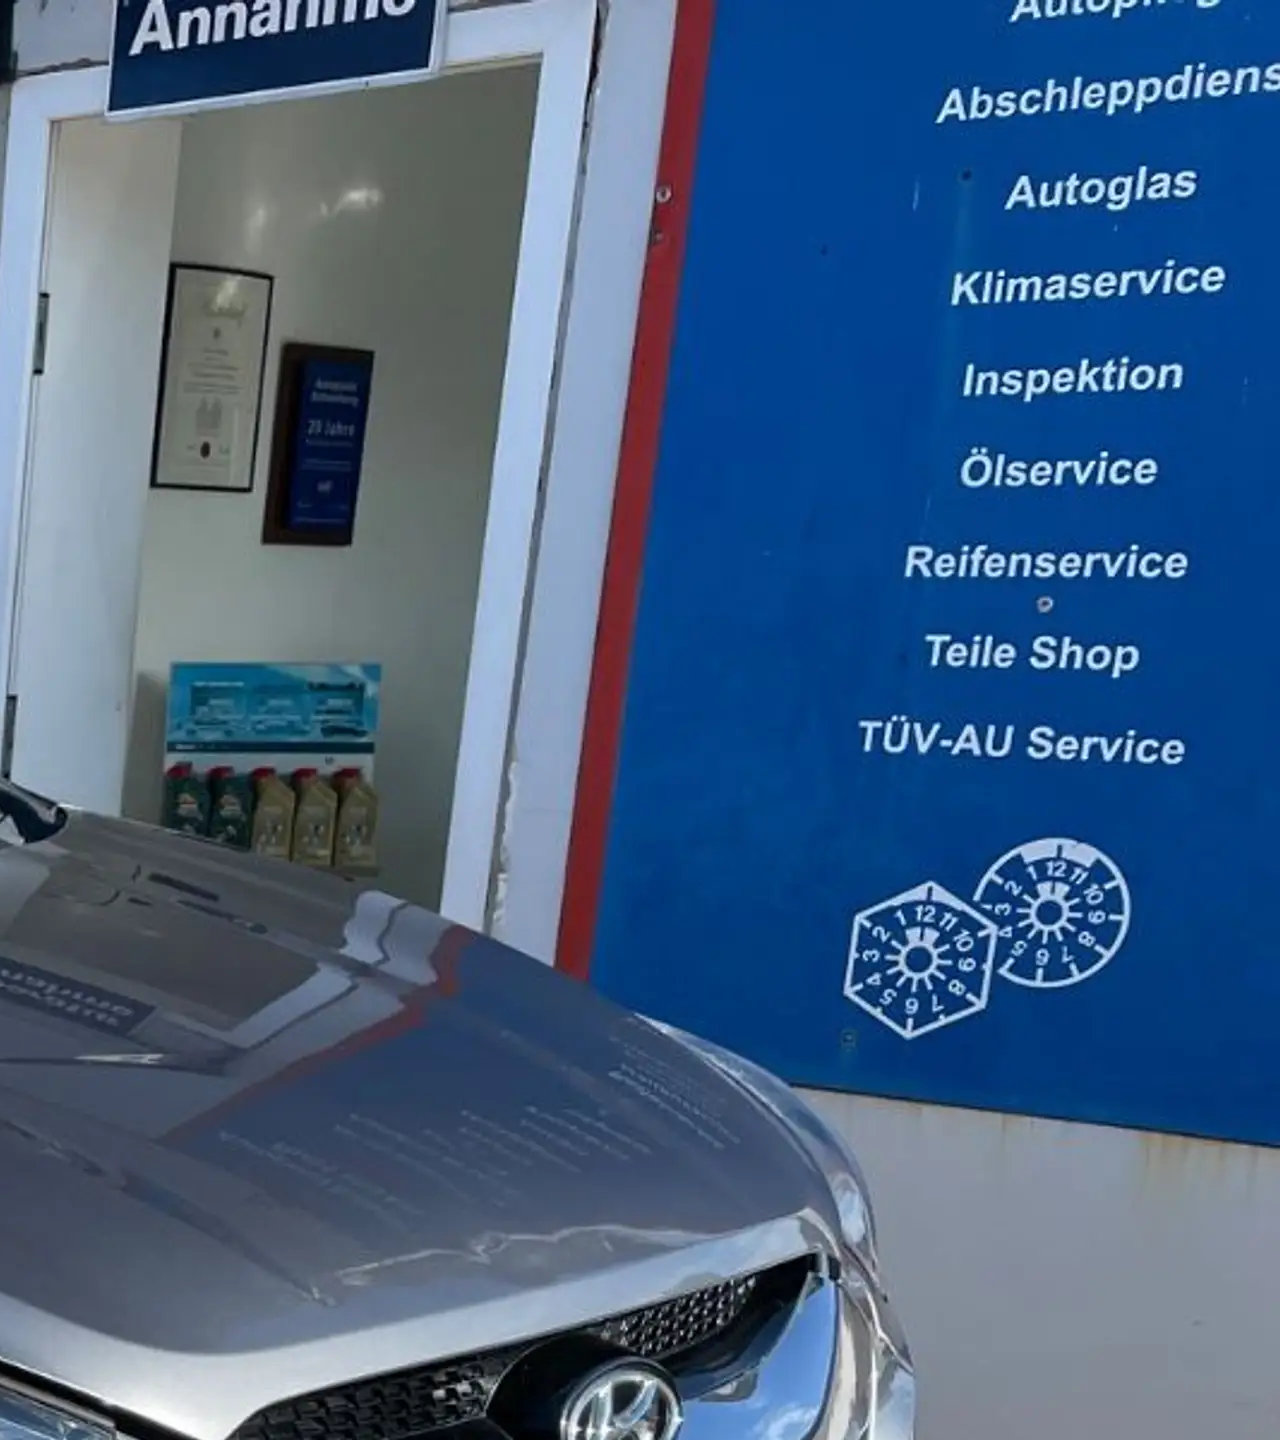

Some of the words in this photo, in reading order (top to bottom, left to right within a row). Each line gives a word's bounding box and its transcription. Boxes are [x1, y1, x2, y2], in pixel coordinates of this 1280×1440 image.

[1004, 166, 1199, 211] Autoglas
[950, 259, 1227, 306] Klimaservice
[963, 356, 1184, 402] Inspektion
[960, 446, 1159, 489] Ölservice
[904, 544, 1189, 580] Reifenservice
[925, 633, 1017, 669] Teile
[1029, 636, 1140, 678] Shop
[858, 714, 1014, 758] TÜV-AU
[1026, 726, 1186, 765] Service
